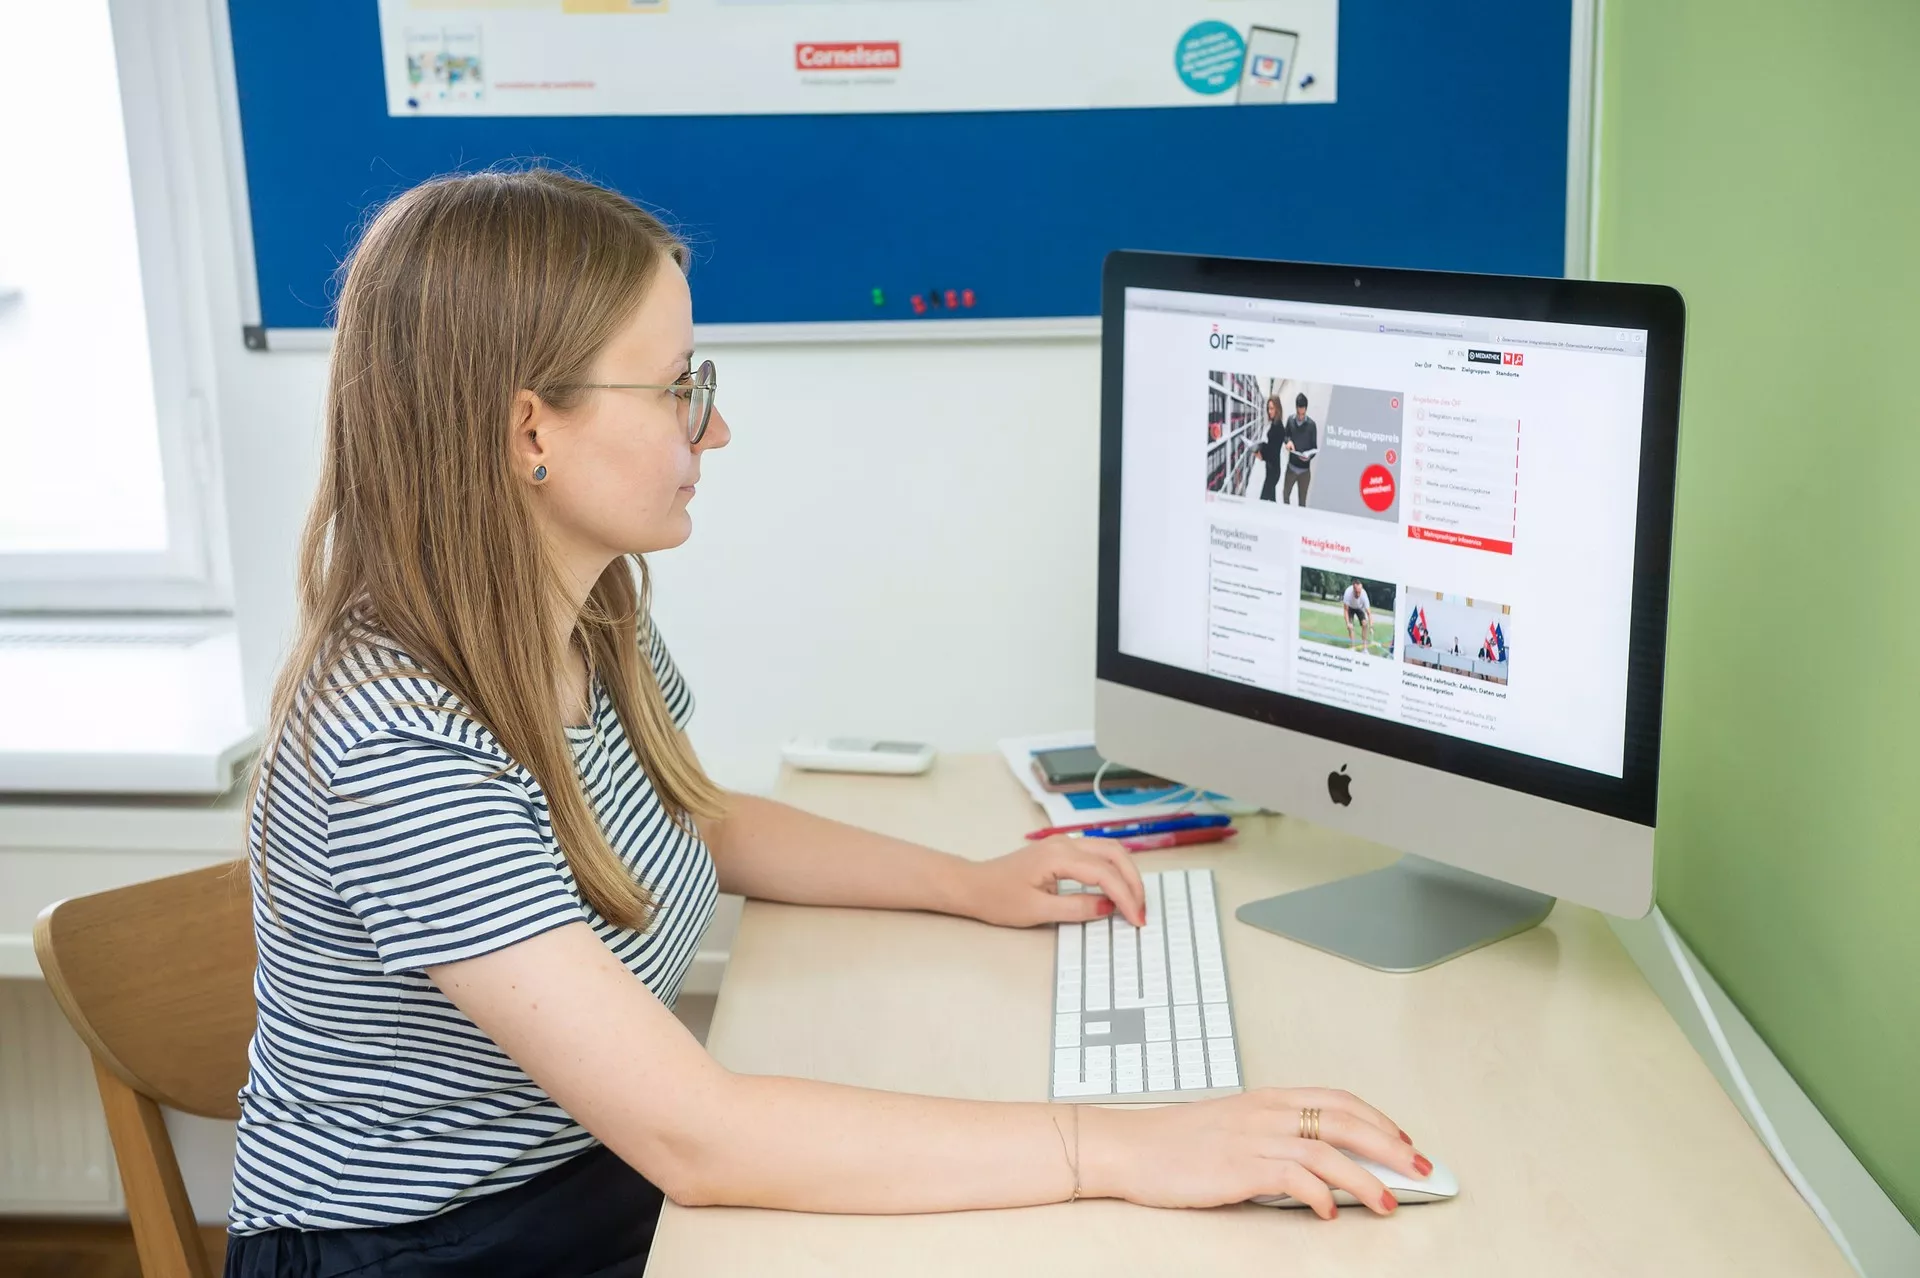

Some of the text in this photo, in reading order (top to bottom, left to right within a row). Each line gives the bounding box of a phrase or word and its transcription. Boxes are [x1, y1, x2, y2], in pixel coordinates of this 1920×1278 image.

[799, 44, 897, 67] Cornelsen
[1475, 352, 1500, 361] MEDIATHEK
[1461, 367, 1490, 375] Zielgruppen
[1495, 370, 1519, 378] Standorte
[1338, 426, 1400, 444] Forschungspreis
[1326, 437, 1368, 452] Integration
[1210, 523, 1258, 542] Perspektiven
[1210, 536, 1252, 552] Integration
[1301, 536, 1351, 553] Neuigkeiten
[1401, 679, 1418, 689] Fakten
[1426, 686, 1454, 697] Integration
[1402, 670, 1432, 682] Statistisches
[1459, 683, 1478, 694] Zahlen,
[1479, 687, 1494, 697] Daten
